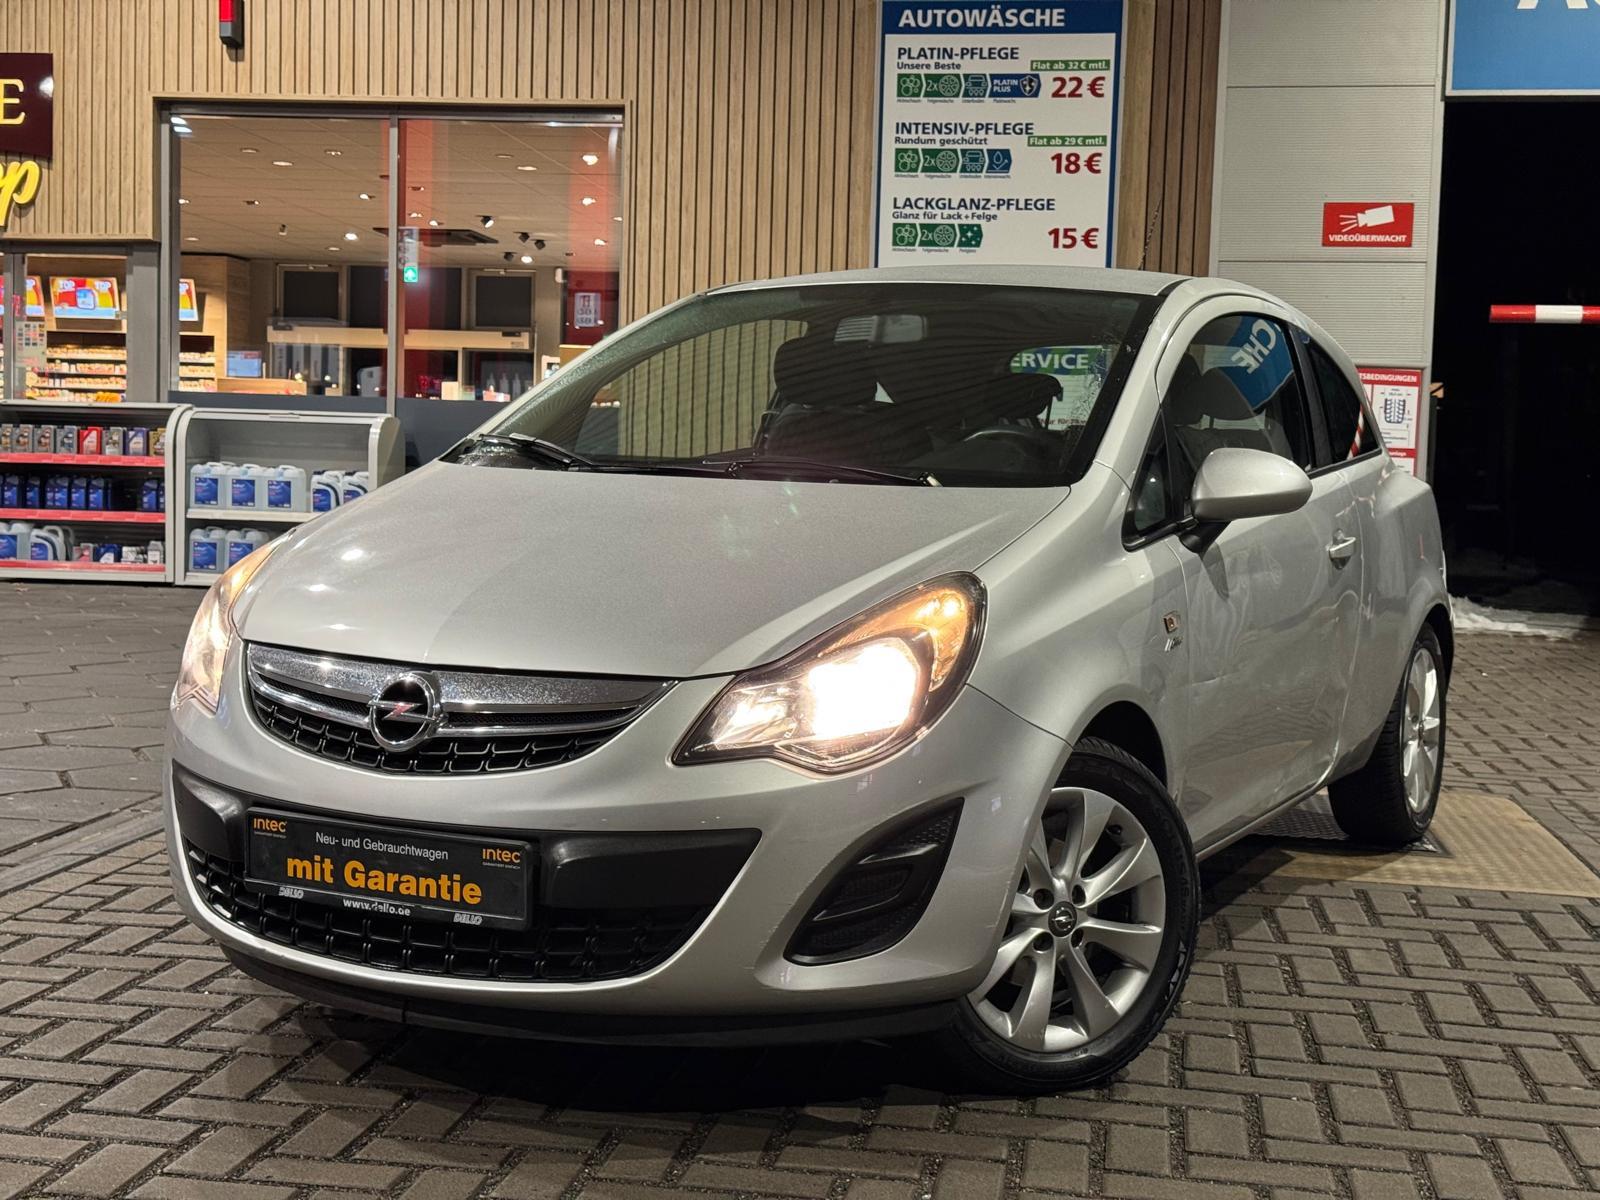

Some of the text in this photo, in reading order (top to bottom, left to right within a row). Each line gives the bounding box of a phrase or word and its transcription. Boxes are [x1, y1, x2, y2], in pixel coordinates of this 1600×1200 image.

[898, 5, 1066, 27] AUTOWÄSCHE
[897, 47, 1020, 60] PLATIN-PFLEGE
[896, 61, 961, 70] Unsere Beste
[1032, 61, 1051, 70] Flat
[1053, 61, 1066, 70] ab
[1088, 61, 1108, 69] mtl.
[926, 80, 938, 92] 2x
[895, 122, 1034, 136] INTENSIV-PFLEGE
[894, 136, 988, 147] Rundum geschützt
[1029, 137, 1048, 145] Flat
[1050, 137, 1062, 145] ab
[1085, 137, 1105, 145] mtl.
[923, 155, 936, 167] 2x
[893, 197, 1056, 211] LACKGLANZ-PFLEGE
[892, 211, 920, 220] Glanz
[923, 211, 938, 220] für
[940, 211, 962, 220] Lack
[971, 212, 998, 222] Felge
[921, 229, 933, 241] 2x
[1328, 232, 1407, 242] VIDEOÜBERWACHT
[253, 817, 287, 833] intec
[315, 831, 449, 861] Neu- und Gebrauchtwagen
[482, 848, 521, 863] intec
[287, 854, 482, 905] mit Garantie
